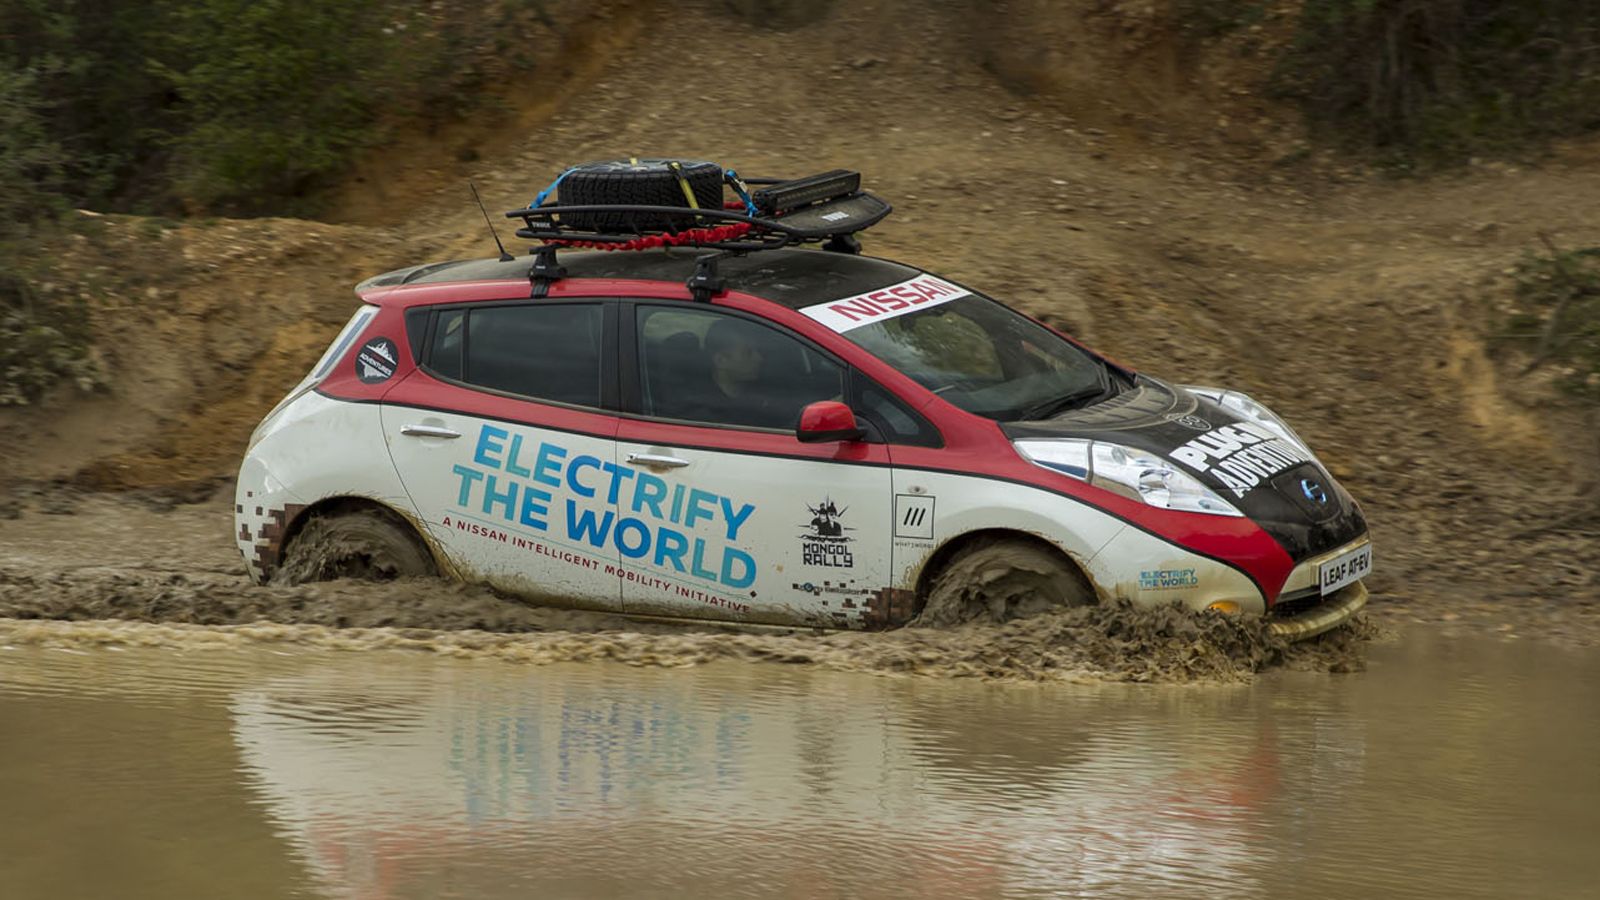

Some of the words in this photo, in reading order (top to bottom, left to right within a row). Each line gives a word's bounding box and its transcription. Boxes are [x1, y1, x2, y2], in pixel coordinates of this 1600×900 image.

[828, 279, 960, 322] NISSAN
[474, 424, 756, 541] ELECTRIFY
[453, 464, 552, 532] THE
[566, 499, 757, 589] WORLD
[802, 543, 853, 556] MONGOL
[802, 553, 854, 568] RALLY
[442, 516, 452, 527] A
[457, 520, 508, 543] NISSAN
[512, 536, 600, 571] INTELLIGENT
[604, 565, 672, 592] MOBILITY
[675, 585, 751, 613] INITIATIVE
[1141, 568, 1196, 579] ELECTRIFY
[1324, 563, 1346, 588] LEAF
[1139, 579, 1158, 587] THE
[1160, 577, 1198, 587] WORLD
